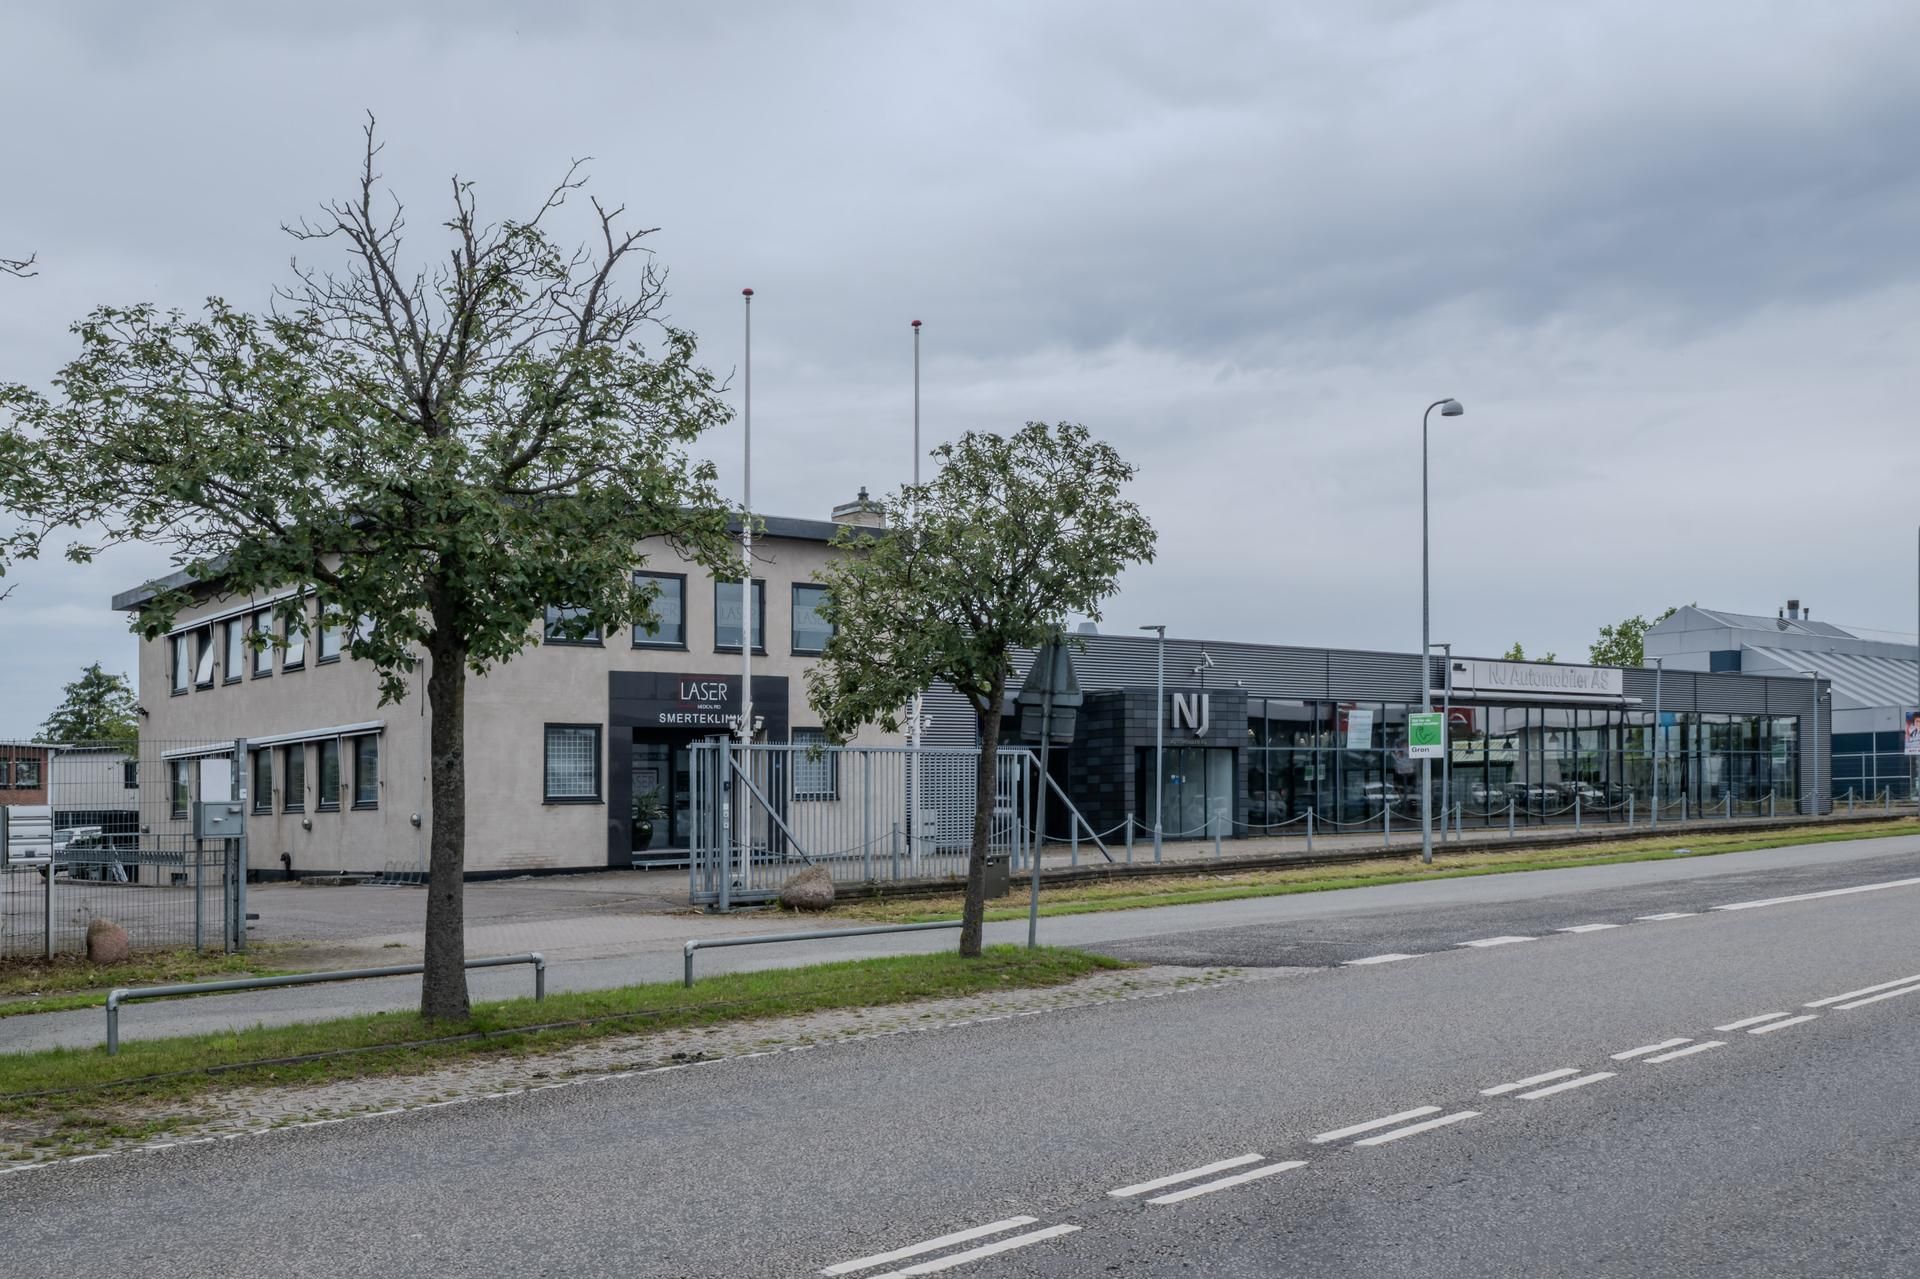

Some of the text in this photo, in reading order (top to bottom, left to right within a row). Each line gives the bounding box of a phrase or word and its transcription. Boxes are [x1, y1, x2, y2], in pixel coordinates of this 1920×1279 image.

[1488, 663, 1609, 690] NJ Automobiler AS
[681, 682, 728, 701] LASER
[1173, 693, 1209, 737] NJ
